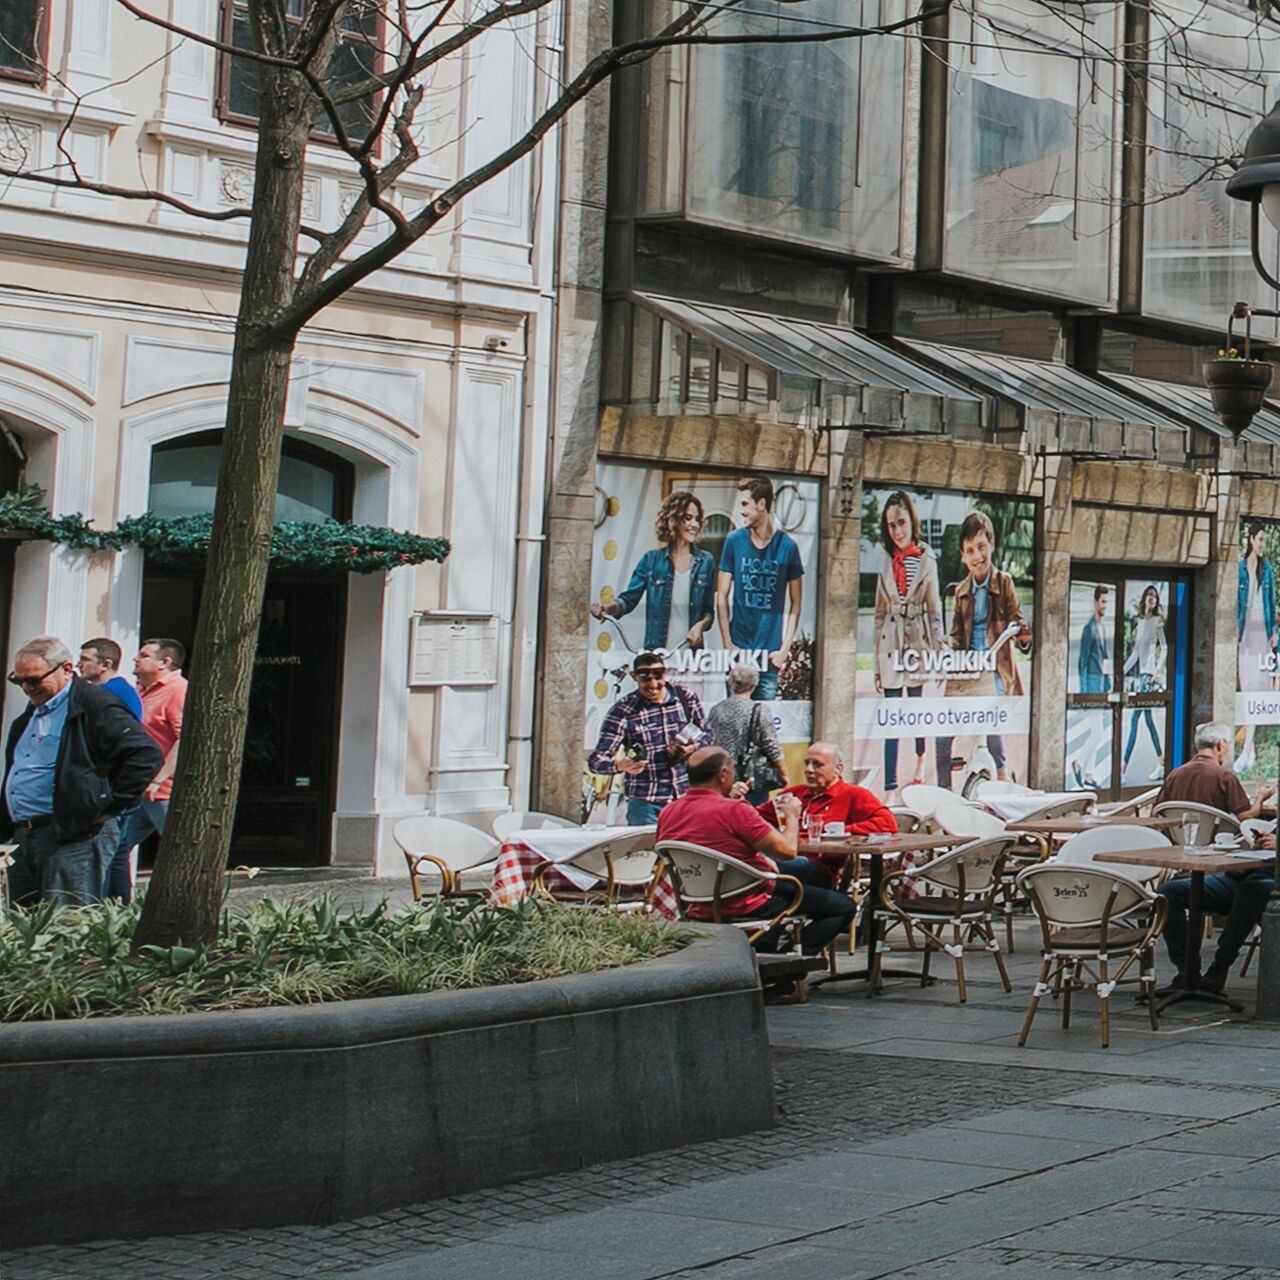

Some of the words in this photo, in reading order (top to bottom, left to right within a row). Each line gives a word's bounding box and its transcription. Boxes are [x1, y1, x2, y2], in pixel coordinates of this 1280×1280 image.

[741, 558, 779, 575] HOLD
[742, 575, 776, 592] YOUR
[745, 592, 772, 609] LIFE
[894, 650, 919, 671] LC
[1259, 653, 1276, 670] LC
[877, 708, 934, 726] Uskoro
[937, 707, 1007, 727] otvaranje
[1053, 887, 1078, 897] Jelen
